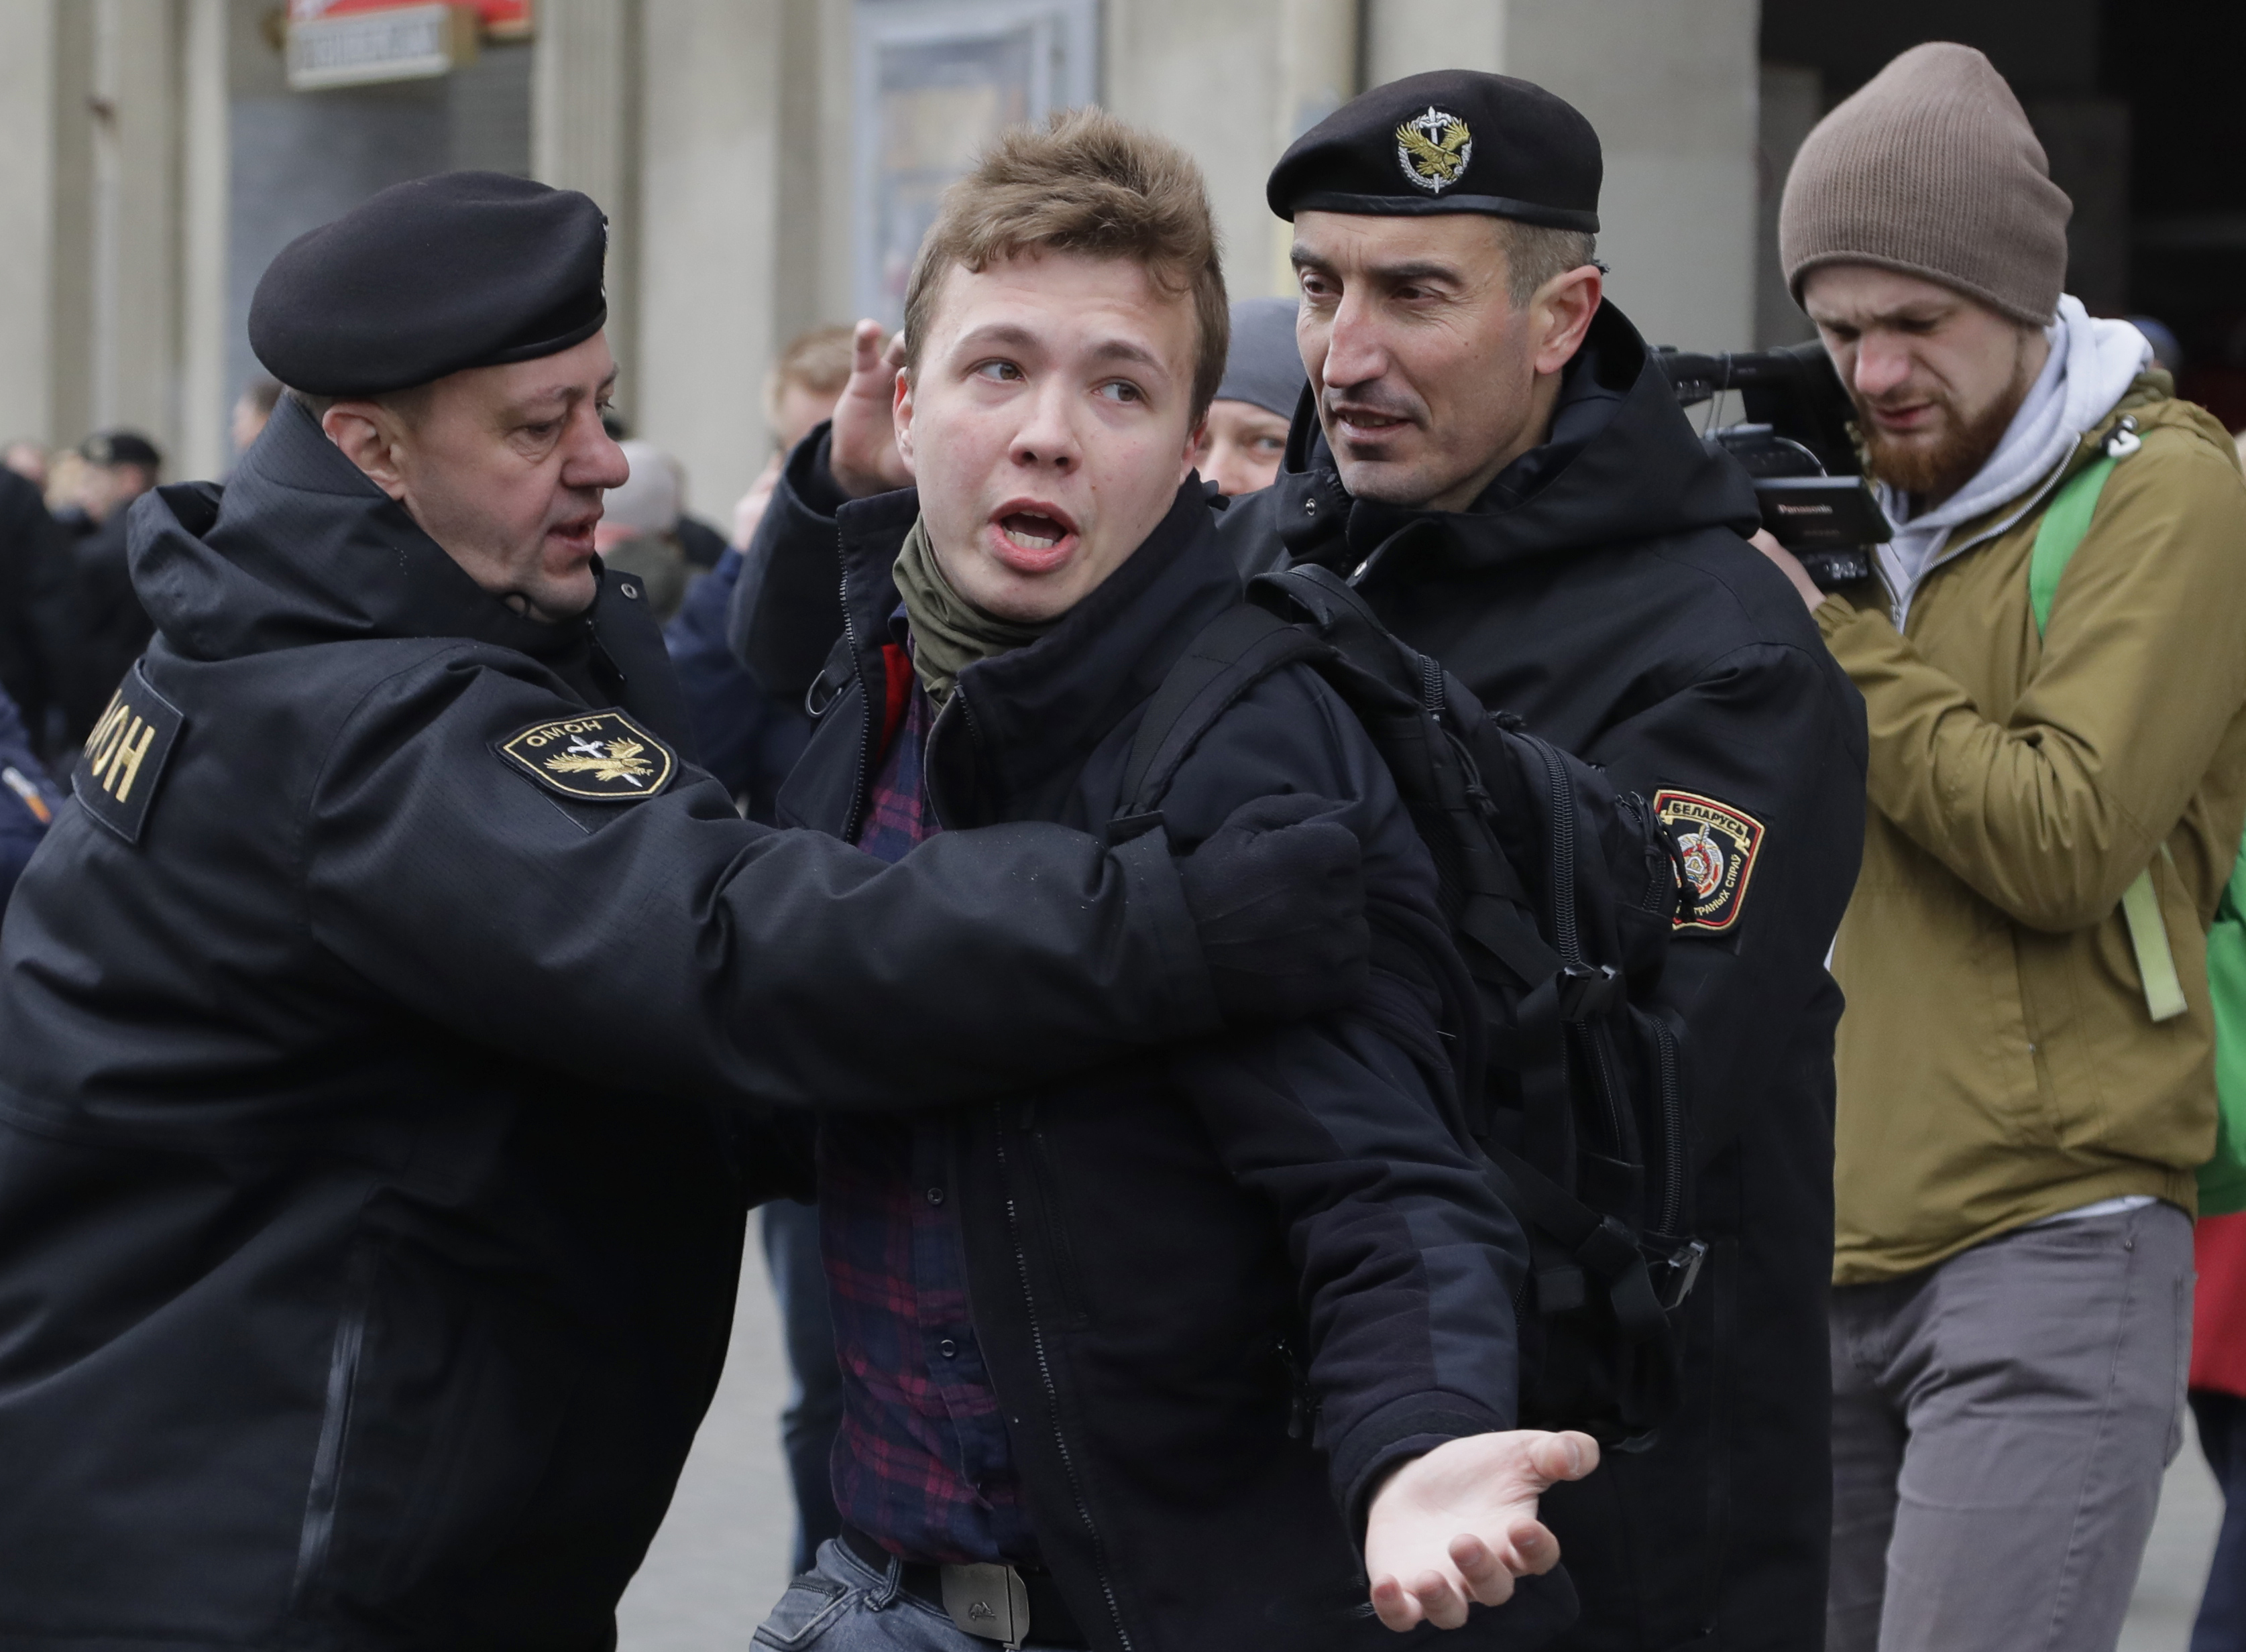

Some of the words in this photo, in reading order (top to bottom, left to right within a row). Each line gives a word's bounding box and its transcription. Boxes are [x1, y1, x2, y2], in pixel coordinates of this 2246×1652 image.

[1779, 504, 1834, 515] Panasonic
[84, 687, 156, 803] МОН
[526, 720, 603, 748] ОМОН
[1672, 803, 1745, 835] БЕЛАРУСЬ
